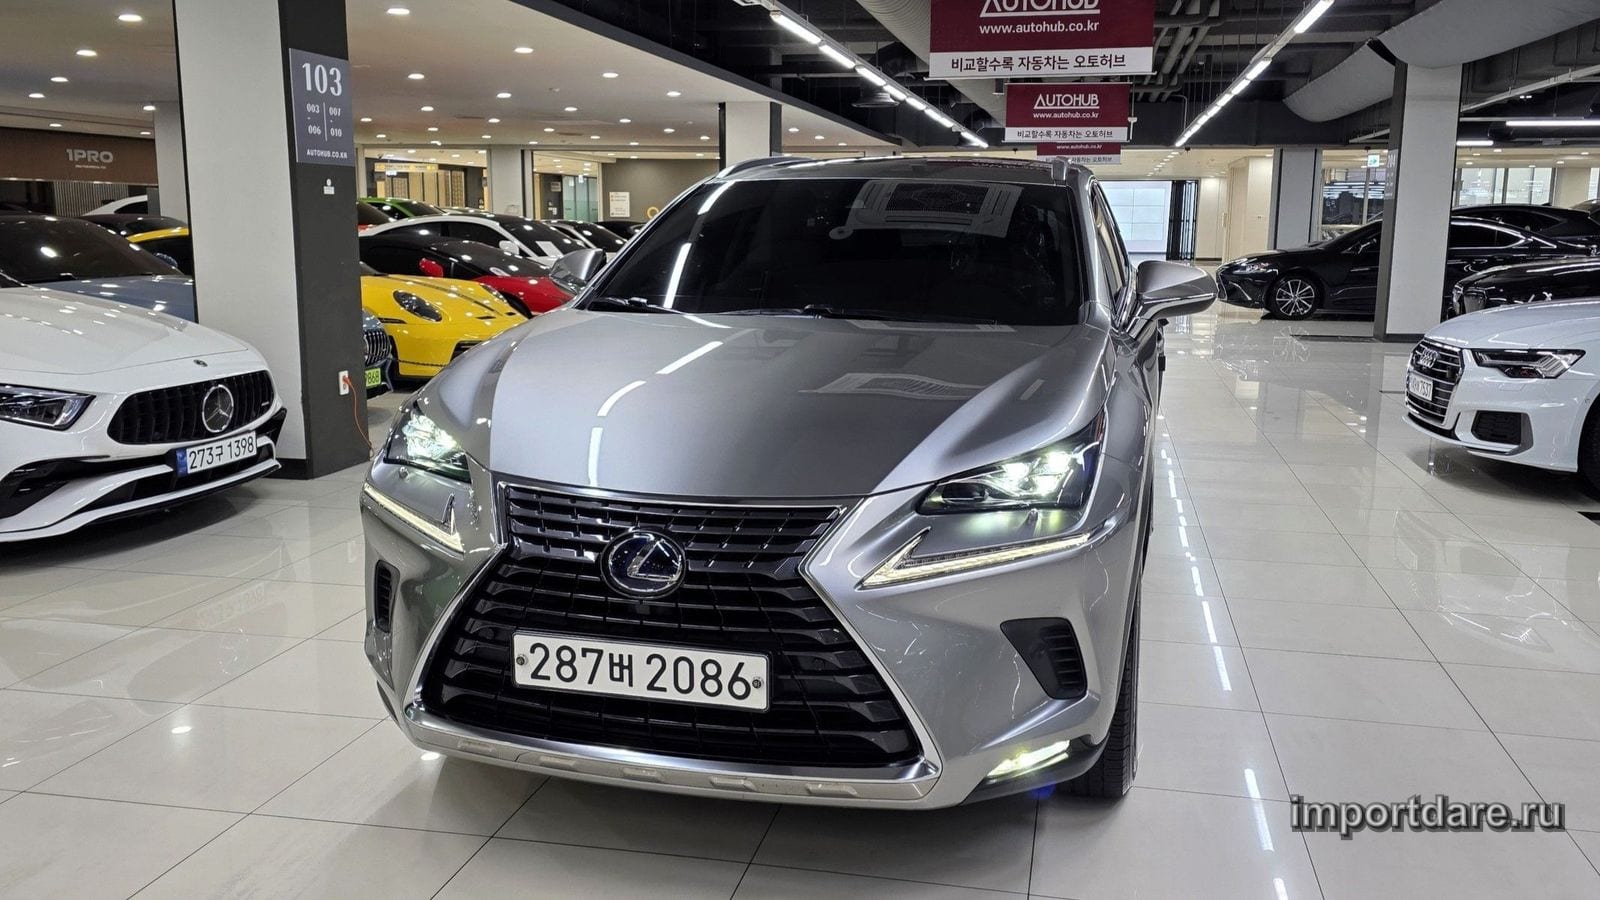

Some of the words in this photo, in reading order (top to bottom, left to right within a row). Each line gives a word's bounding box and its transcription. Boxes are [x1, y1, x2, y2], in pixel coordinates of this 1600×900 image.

[979, 19, 1100, 35] www.autohub.co.kr
[951, 57, 1014, 73] 비교할수록
[1018, 55, 1070, 72] 자동차는
[1073, 53, 1126, 69] 오토허브
[302, 62, 342, 97] 103
[306, 103, 320, 114] 003
[1033, 93, 1100, 110] AUTOHUB
[1033, 111, 1100, 119] www.autohub.co.kr
[308, 124, 322, 135] 006
[330, 127, 343, 137] 010
[1017, 130, 1052, 139] 비교할수록
[1054, 130, 1083, 139] 자동차는
[1085, 130, 1113, 138] 오토허브
[66, 148, 114, 163] 1PRO
[306, 148, 348, 159] AUTOHUB.CO.KR
[188, 445, 223, 470] 273구
[227, 436, 254, 459] 1398
[529, 642, 634, 688] 287버
[646, 653, 752, 701] 2086
